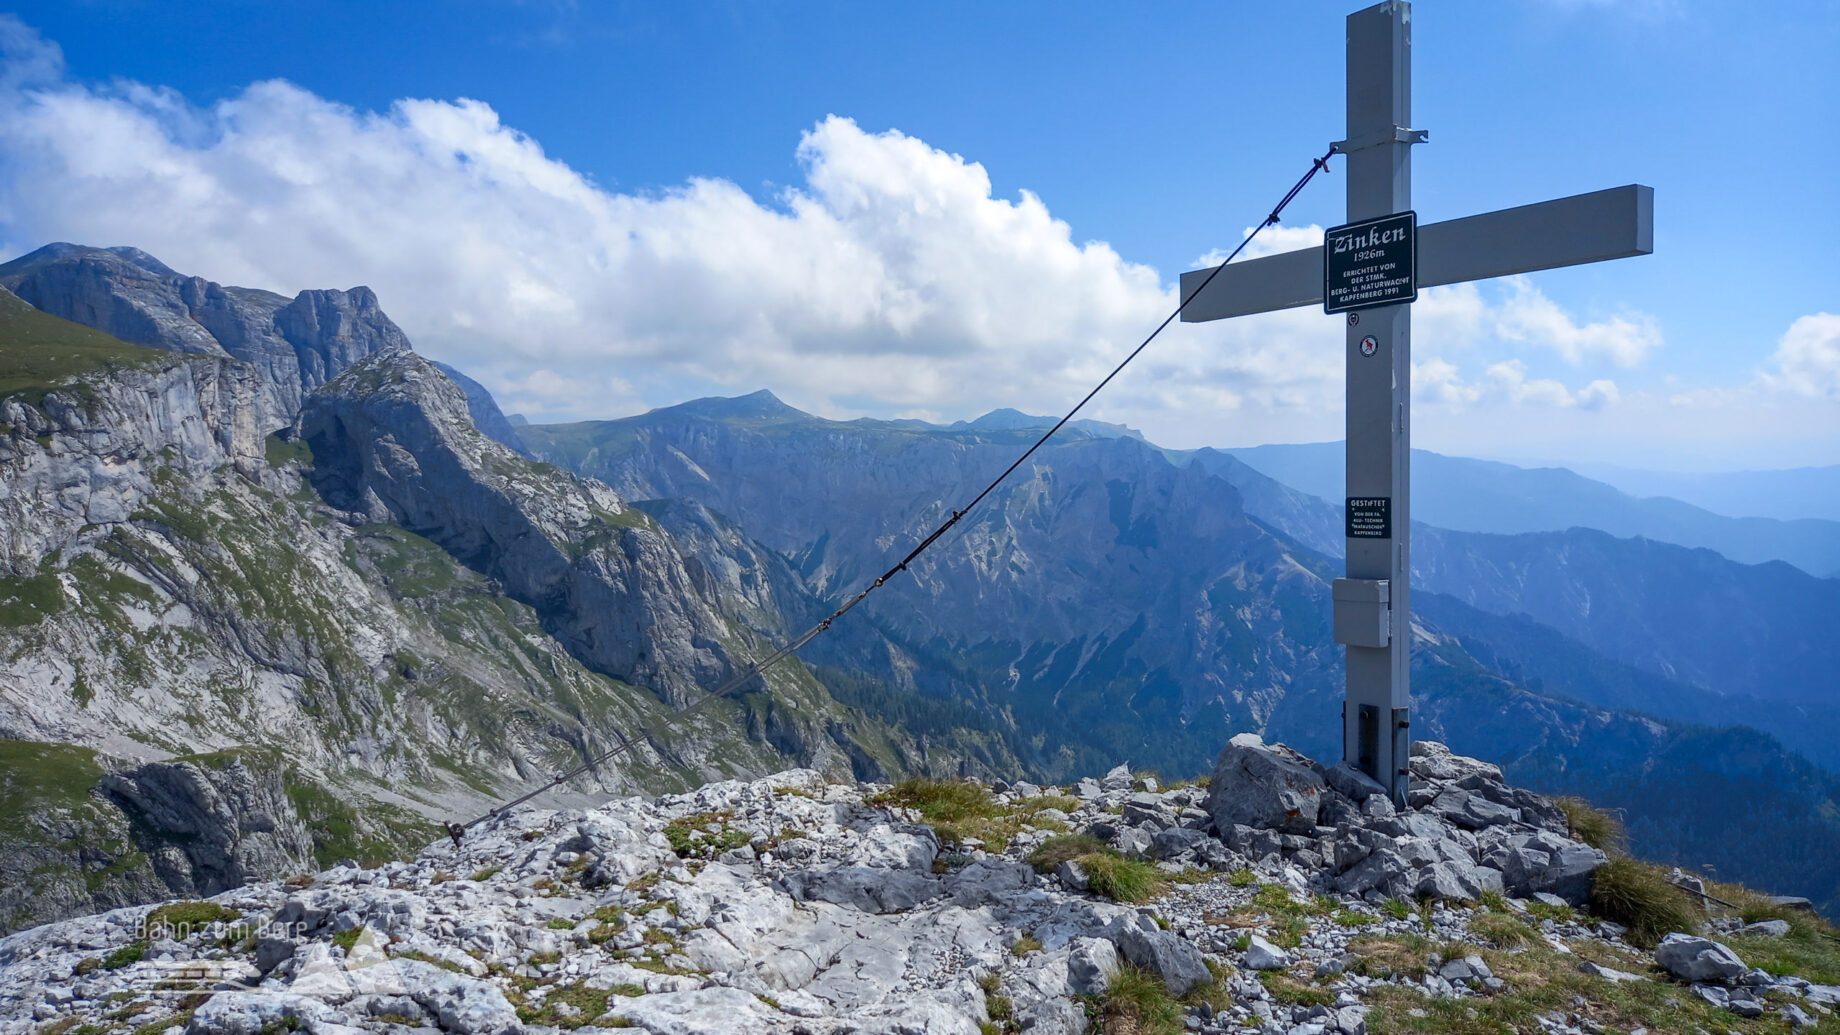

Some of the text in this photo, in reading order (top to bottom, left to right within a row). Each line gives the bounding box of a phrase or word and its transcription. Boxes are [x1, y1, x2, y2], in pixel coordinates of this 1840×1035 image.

[1334, 226, 1406, 254] Zinken
[1354, 249, 1385, 262] 1926m
[1343, 263, 1396, 278] ERRICHTET VON
[1365, 273, 1387, 282] STMK.
[1361, 277, 1410, 290] NATURWACHT
[1340, 287, 1399, 302] KAPFENBERG 1991
